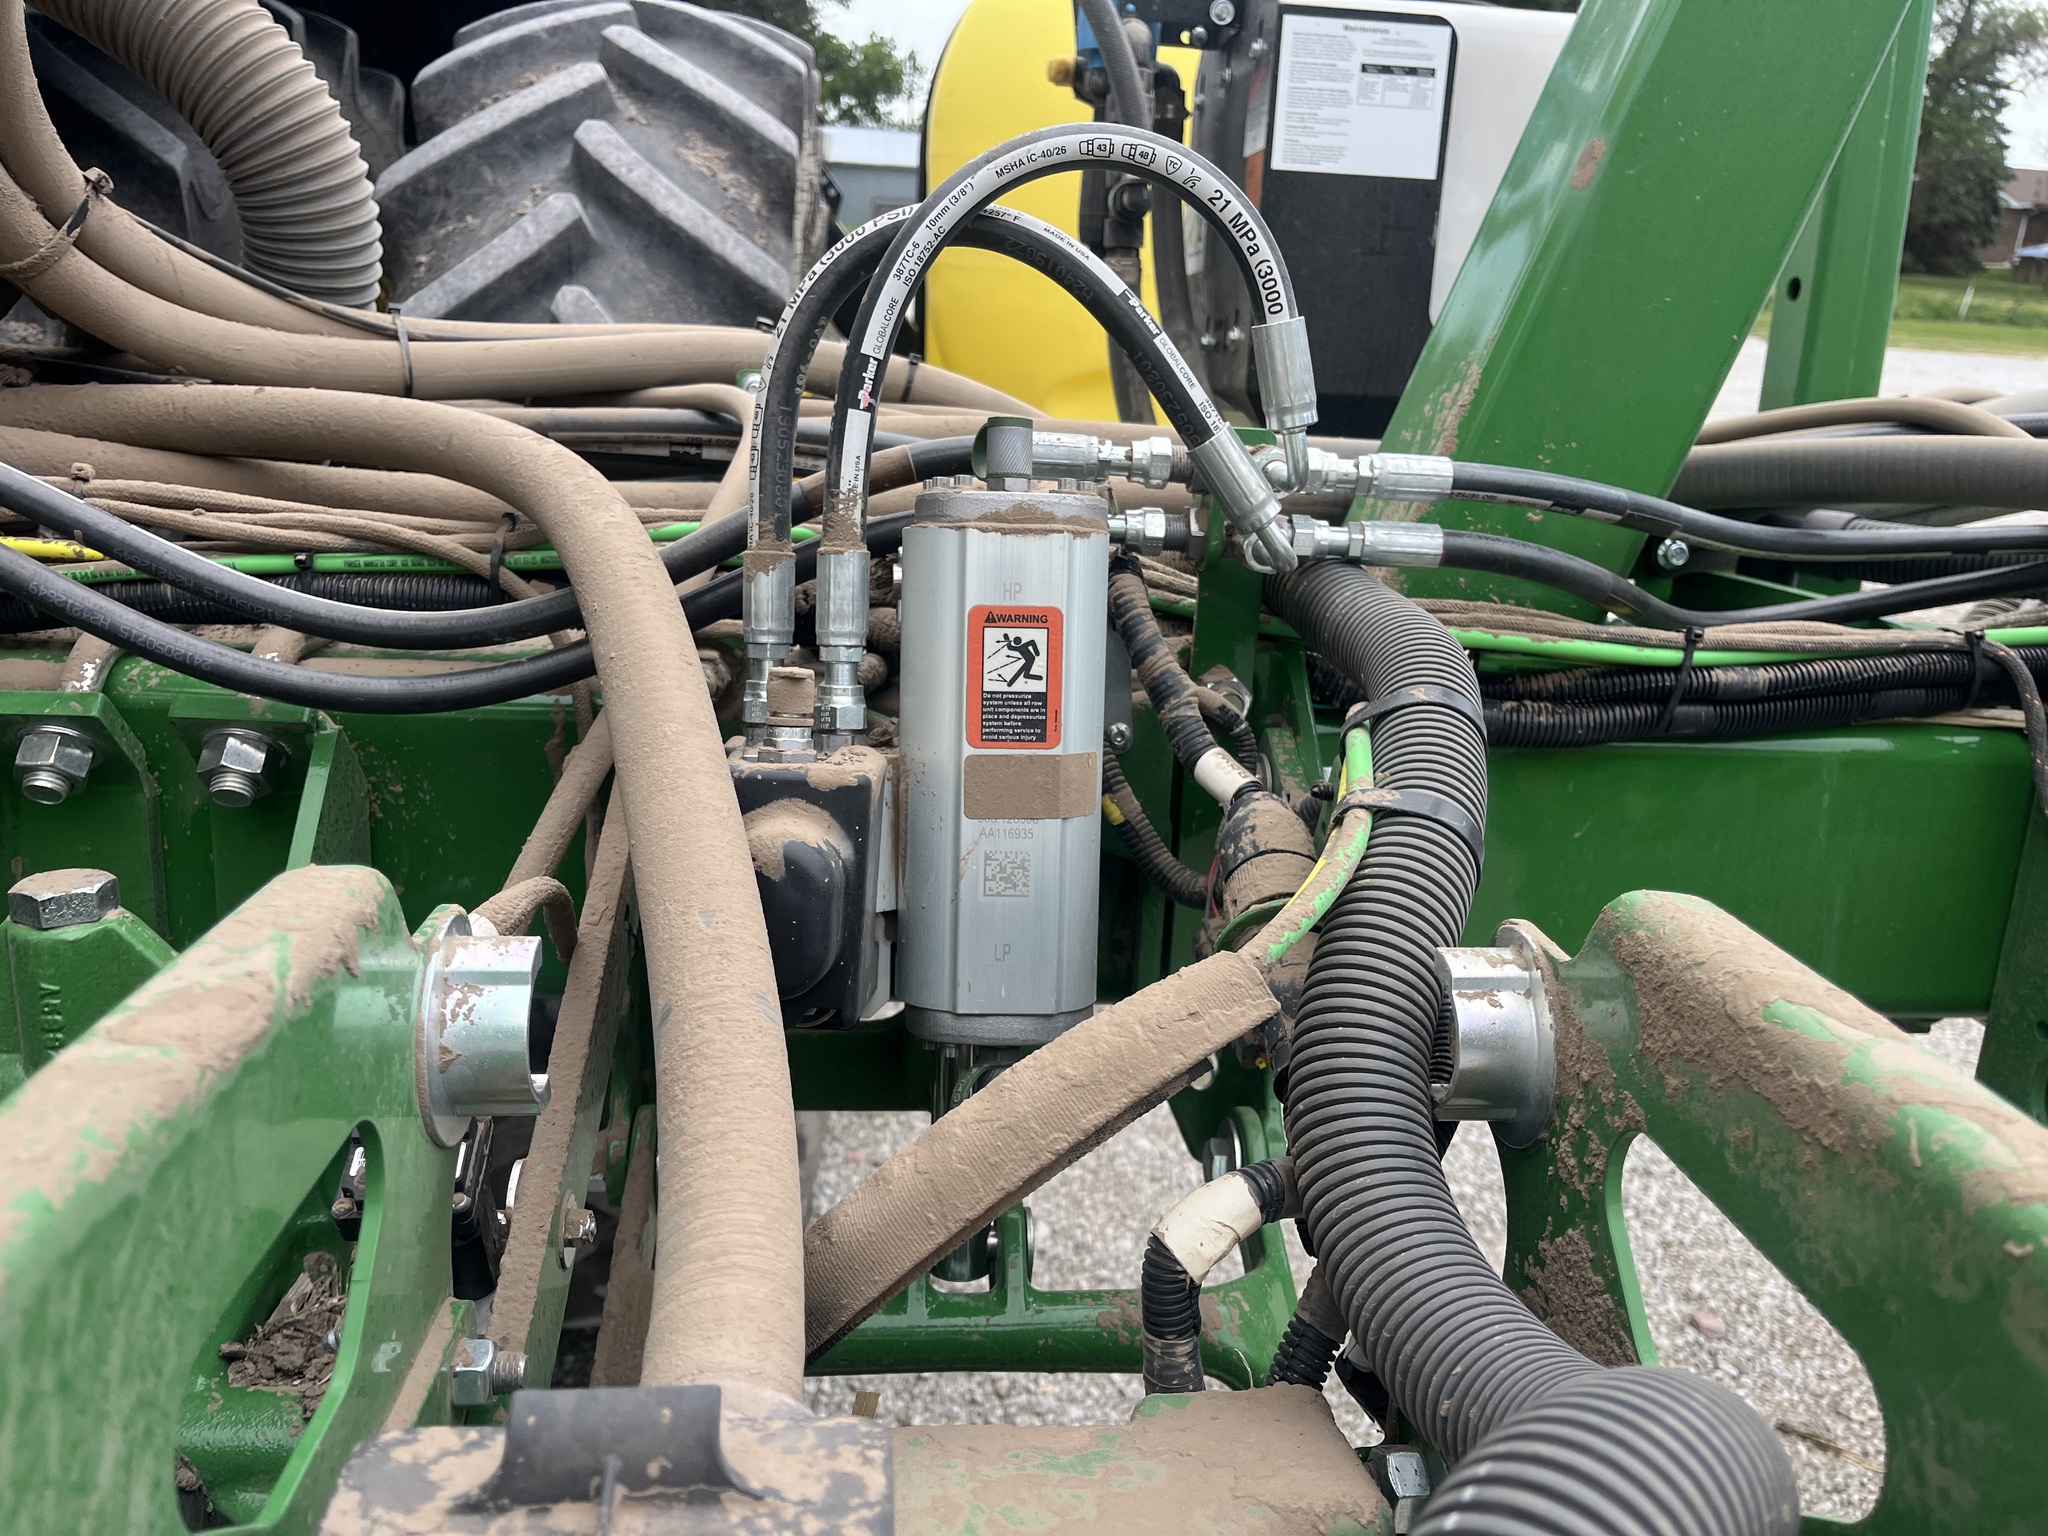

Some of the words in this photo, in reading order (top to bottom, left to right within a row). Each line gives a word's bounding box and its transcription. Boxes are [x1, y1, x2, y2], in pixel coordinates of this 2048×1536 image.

[1096, 143, 1107, 152] 43
[1138, 149, 1149, 160] 48
[1168, 160, 1178, 169] TC
[893, 241, 920, 281] 387TC-6
[925, 205, 951, 231] 10mm
[948, 181, 974, 206] (3/8")
[995, 158, 1026, 179] MSHA
[1026, 145, 1067, 164] IC-40/26
[1043, 227, 1065, 242] MADE
[1066, 240, 1075, 248] IN
[1075, 247, 1090, 261] USA
[1207, 189, 1232, 213] 21
[1228, 211, 1260, 257] MPa
[1254, 258, 1284, 315] (3000
[903, 268, 916, 287] ISO
[914, 226, 946, 267] 18752-AC
[787, 269, 818, 310] MPa
[873, 297, 899, 355] GLOBALCORE
[1125, 290, 1161, 336] Parker
[1160, 338, 1196, 390] GLOBALCORE
[1199, 401, 1212, 419] ISO
[1003, 581, 1022, 601] HP
[996, 614, 1048, 623] WARNING
[980, 827, 1034, 839] AA116935
[994, 943, 1011, 961] LP
